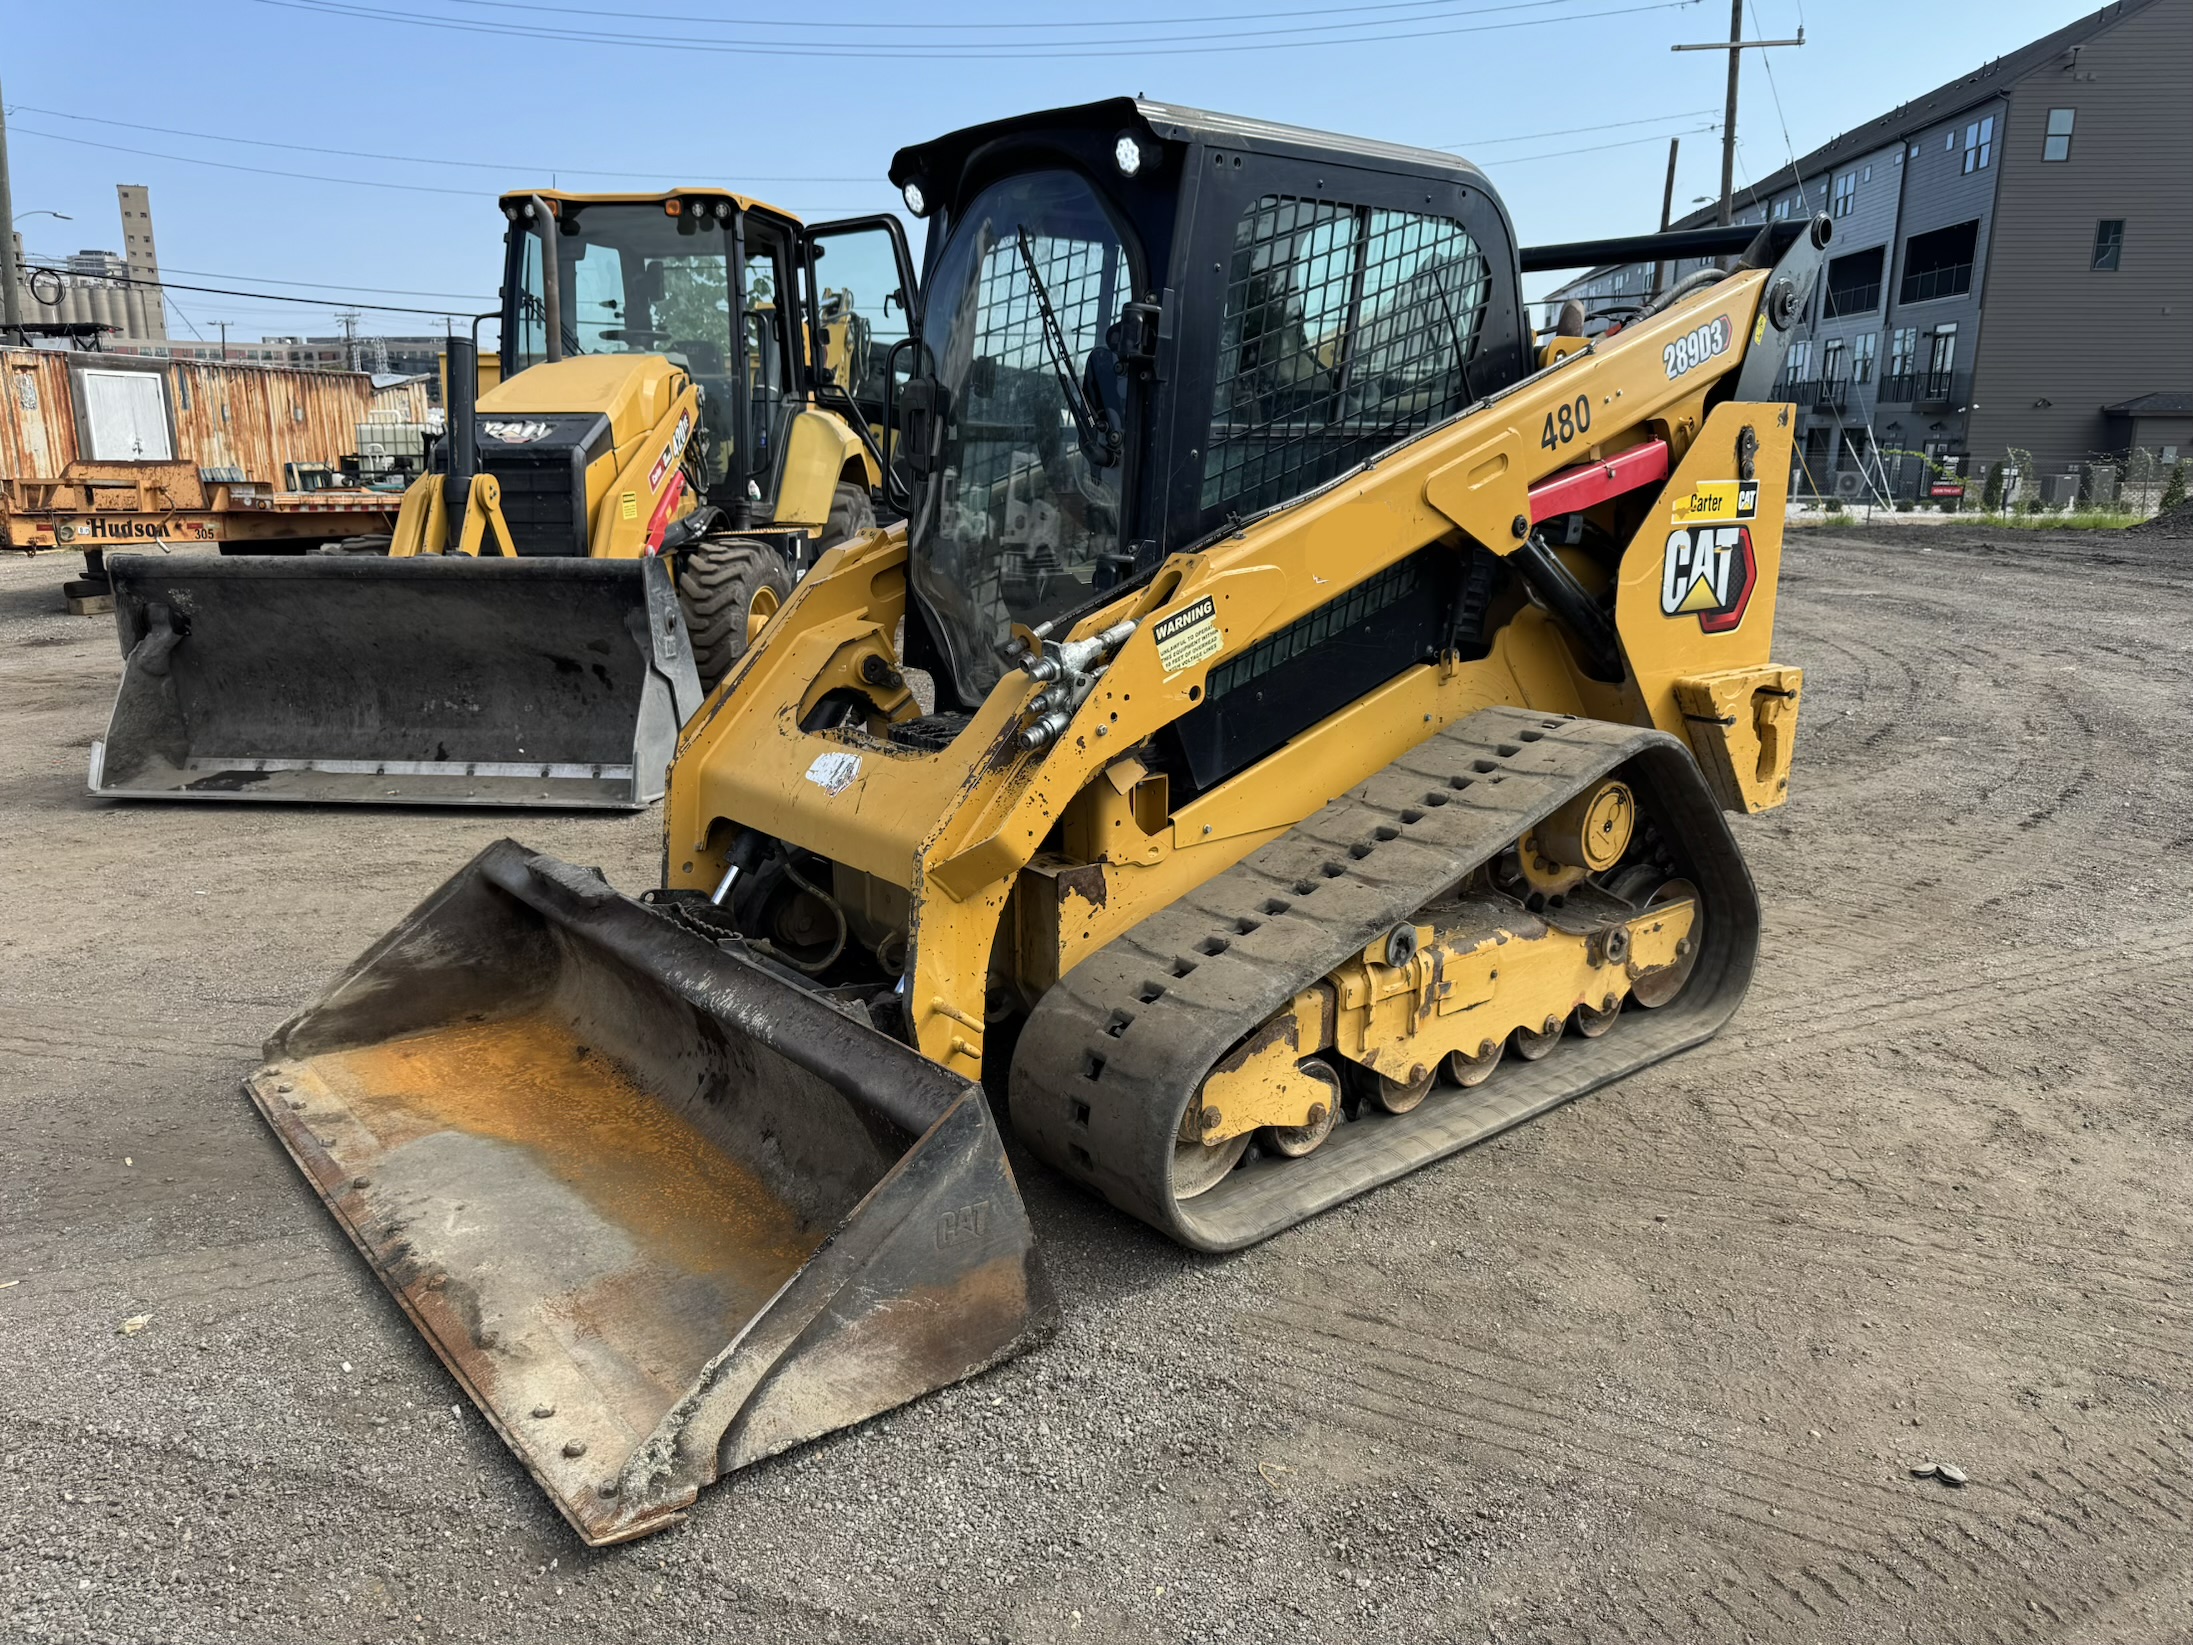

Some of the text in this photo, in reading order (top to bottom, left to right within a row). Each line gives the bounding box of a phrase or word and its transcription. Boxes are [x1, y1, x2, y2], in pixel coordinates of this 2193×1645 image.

[1663, 319, 1723, 380] 289D3
[1541, 394, 1591, 451] 480
[1690, 490, 1757, 513] Carter CAT
[86, 518, 171, 538] Hudson
[194, 528, 214, 540] 305
[1662, 528, 1740, 614] CAT
[1155, 601, 1213, 640] WARNING
[1160, 639, 1187, 657] UNLAWFUL
[1195, 624, 1215, 638] OPERAT
[1161, 628, 1219, 664] THIS EQUIPMENT WITHIN
[1172, 655, 1184, 667] FEET
[1184, 651, 1192, 659] OF
[1192, 635, 1218, 654] OVERHEAD
[1181, 651, 1203, 667] VOLTAGE
[1203, 644, 1218, 655] LINES
[936, 1200, 990, 1250] CAT
